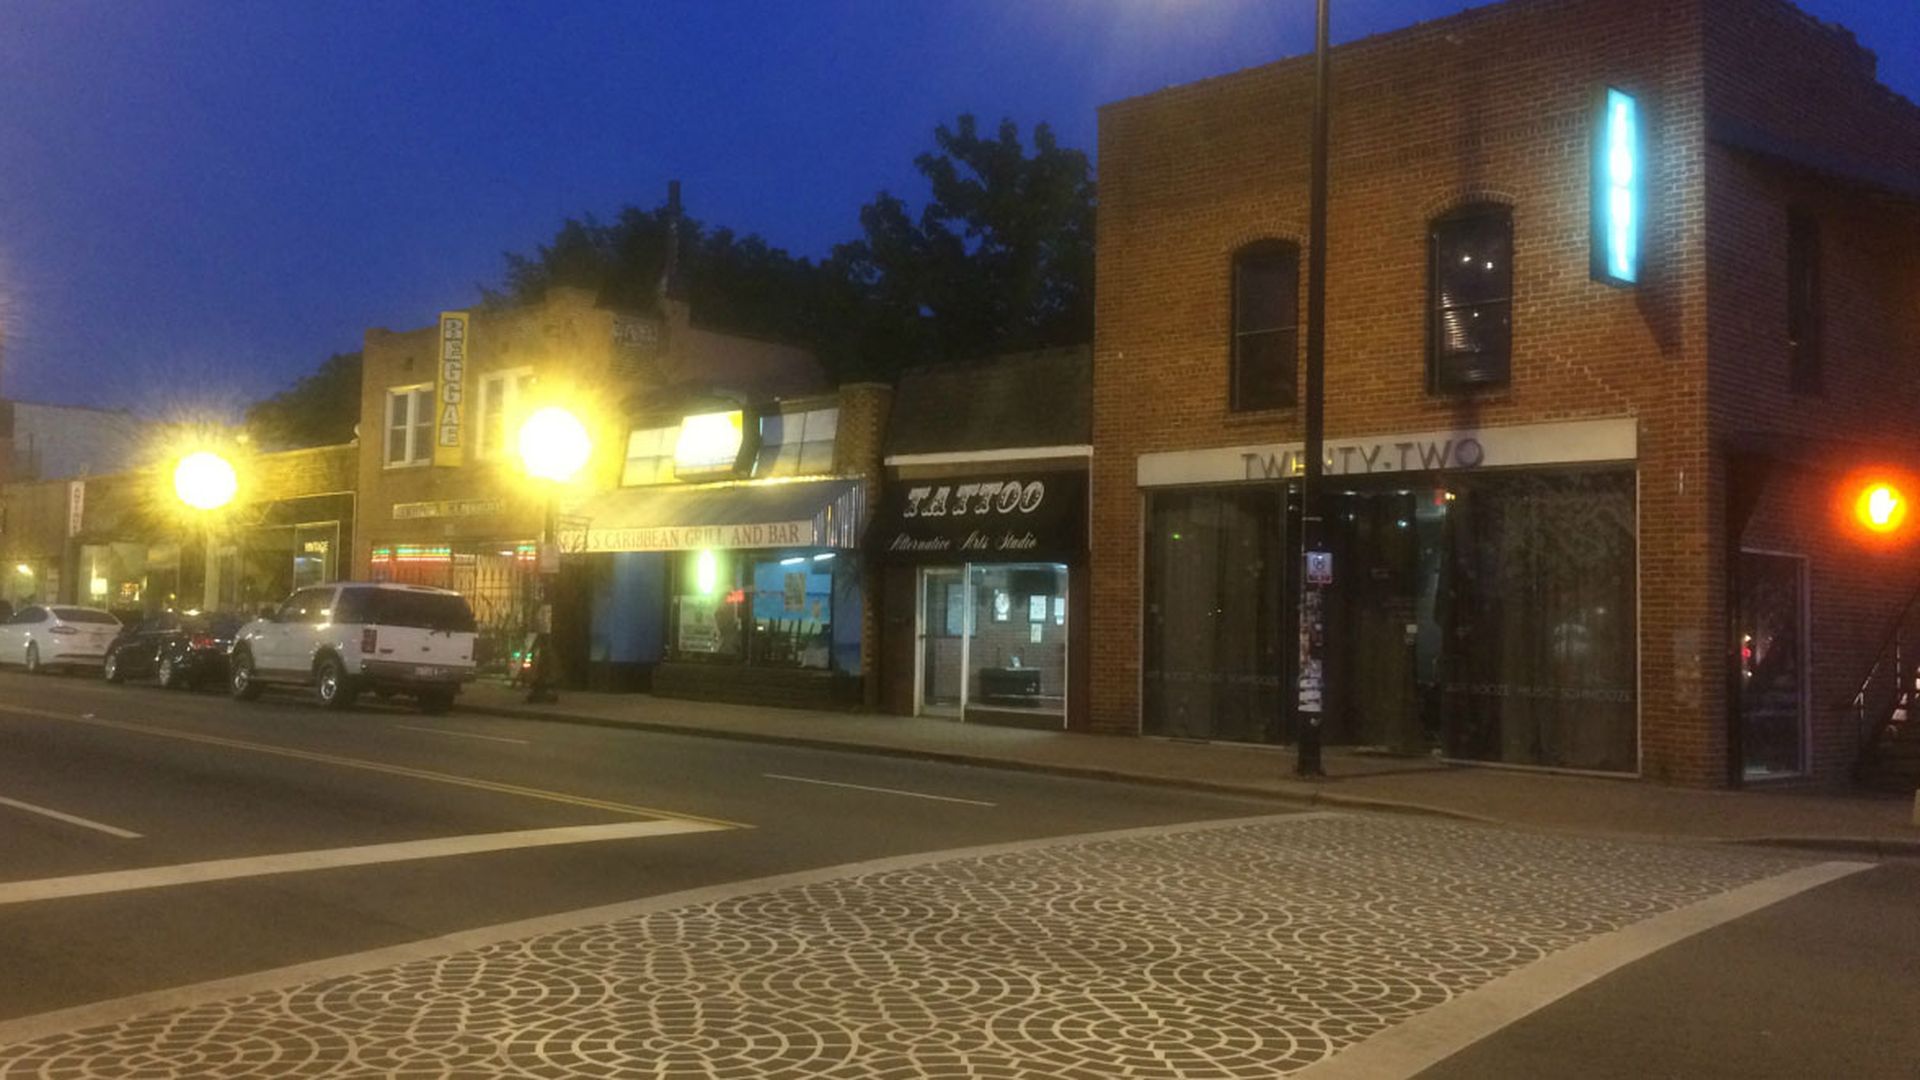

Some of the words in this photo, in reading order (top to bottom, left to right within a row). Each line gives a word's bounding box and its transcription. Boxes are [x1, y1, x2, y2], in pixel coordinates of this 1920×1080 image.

[440, 317, 463, 446] REGGAE
[903, 481, 1045, 518] TATTOO
[604, 528, 682, 549] CARIBBEAN
[685, 526, 722, 547] GRILL
[732, 524, 763, 545] AND
[768, 522, 801, 543] BAR
[890, 532, 951, 551] Alternative
[961, 530, 988, 551] Arts
[999, 530, 1038, 551] Studio
